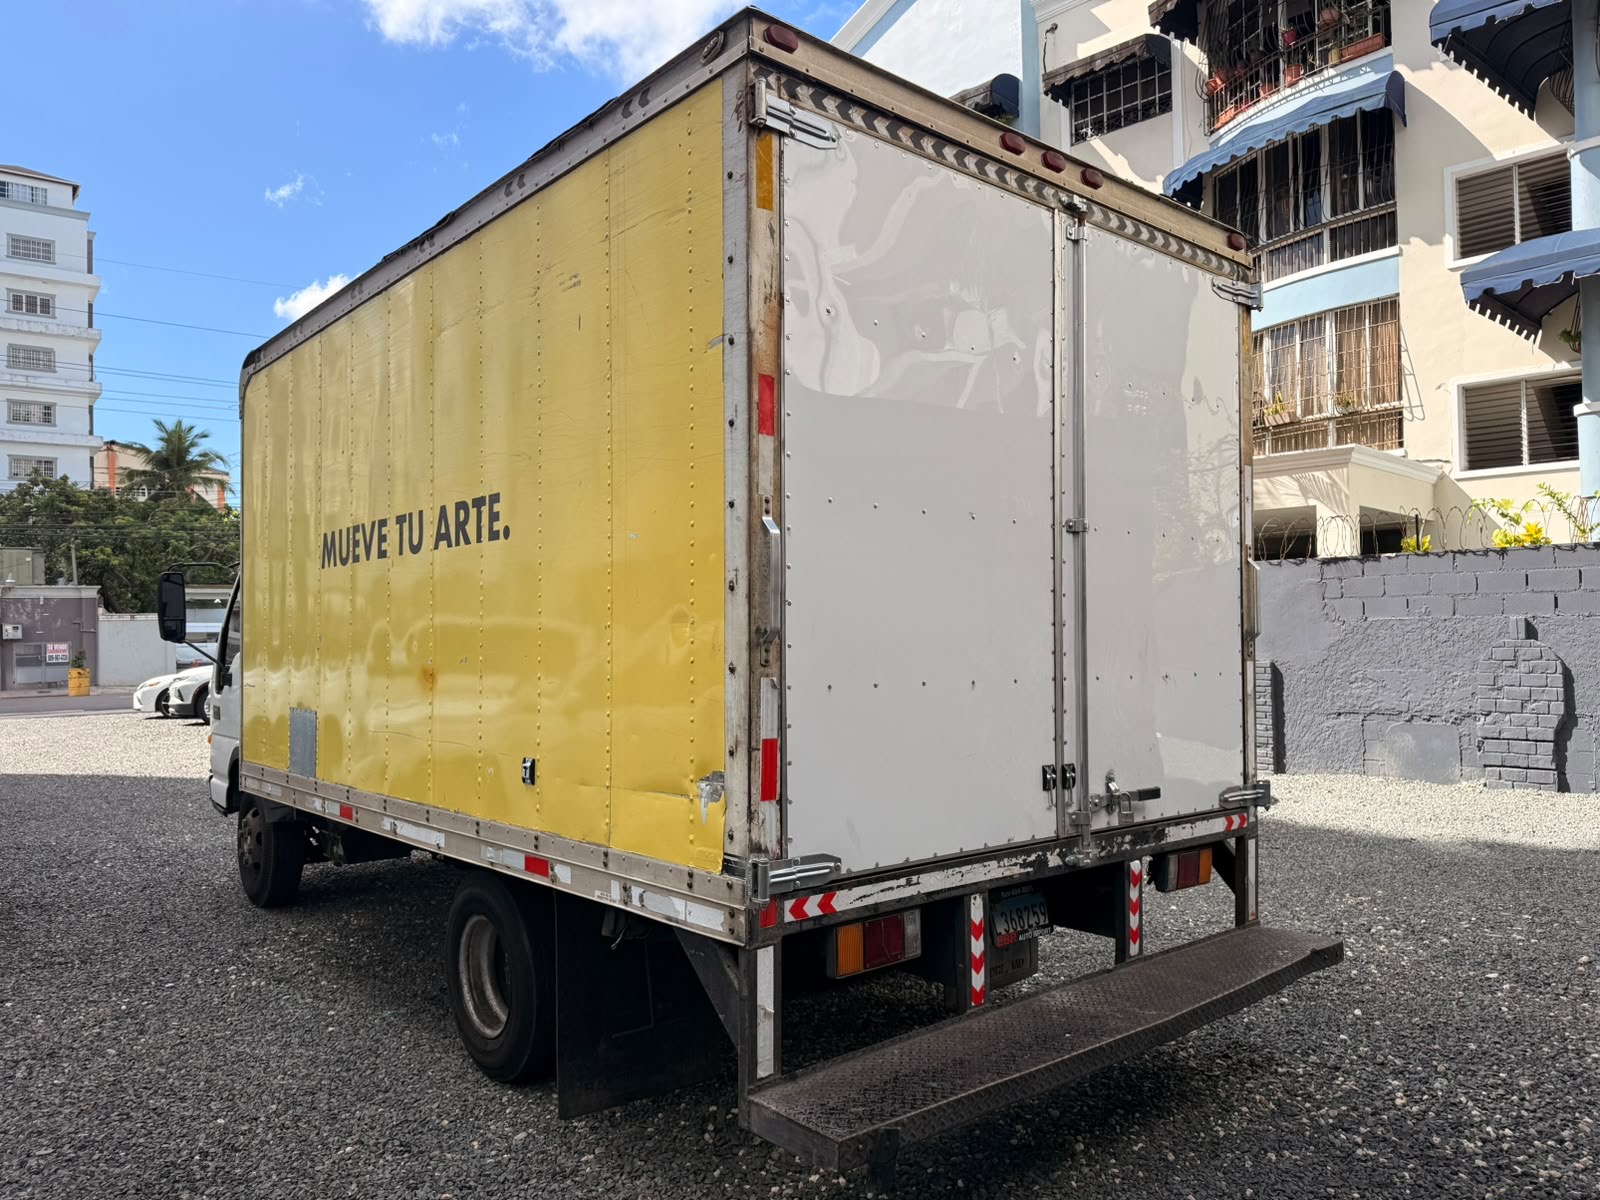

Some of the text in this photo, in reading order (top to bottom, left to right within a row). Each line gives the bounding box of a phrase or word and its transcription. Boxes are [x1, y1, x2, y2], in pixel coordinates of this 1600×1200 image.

[321, 492, 511, 570] MUEVE TU ARTE.
[1018, 931, 1033, 942] AUTO
[1033, 927, 1052, 938] IMPORT
